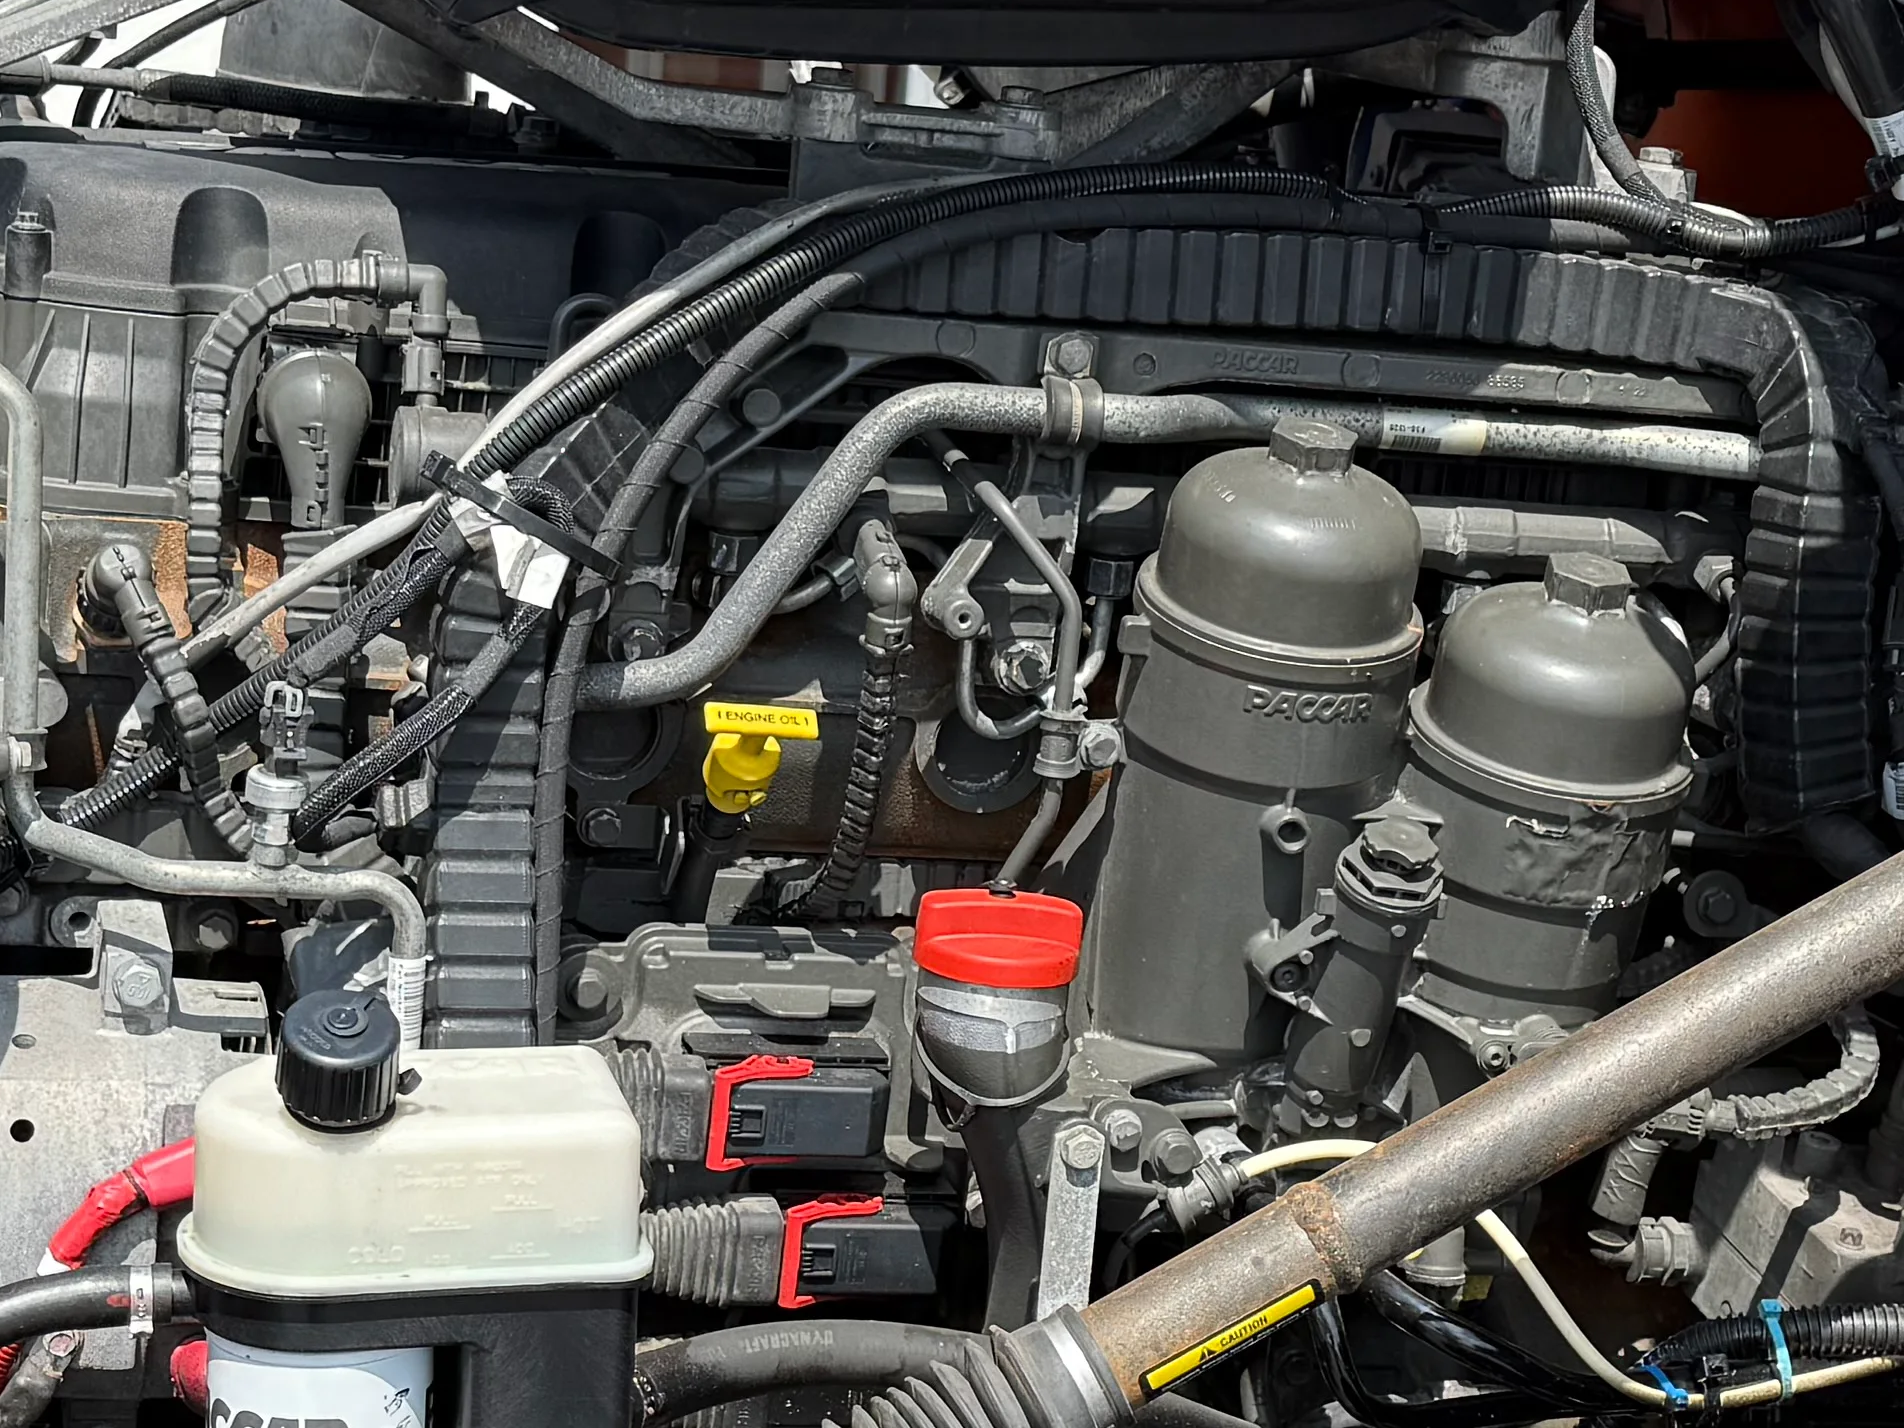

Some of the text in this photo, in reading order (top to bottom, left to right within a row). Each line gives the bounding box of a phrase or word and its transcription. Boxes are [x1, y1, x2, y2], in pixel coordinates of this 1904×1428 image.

[1210, 348, 1299, 374] PACCAR
[1244, 684, 1373, 723] PACCAR
[726, 711, 800, 725] ENGINE OIL
[745, 1330, 833, 1353] DYNACRAFT
[1220, 1315, 1268, 1348] CAUTION
